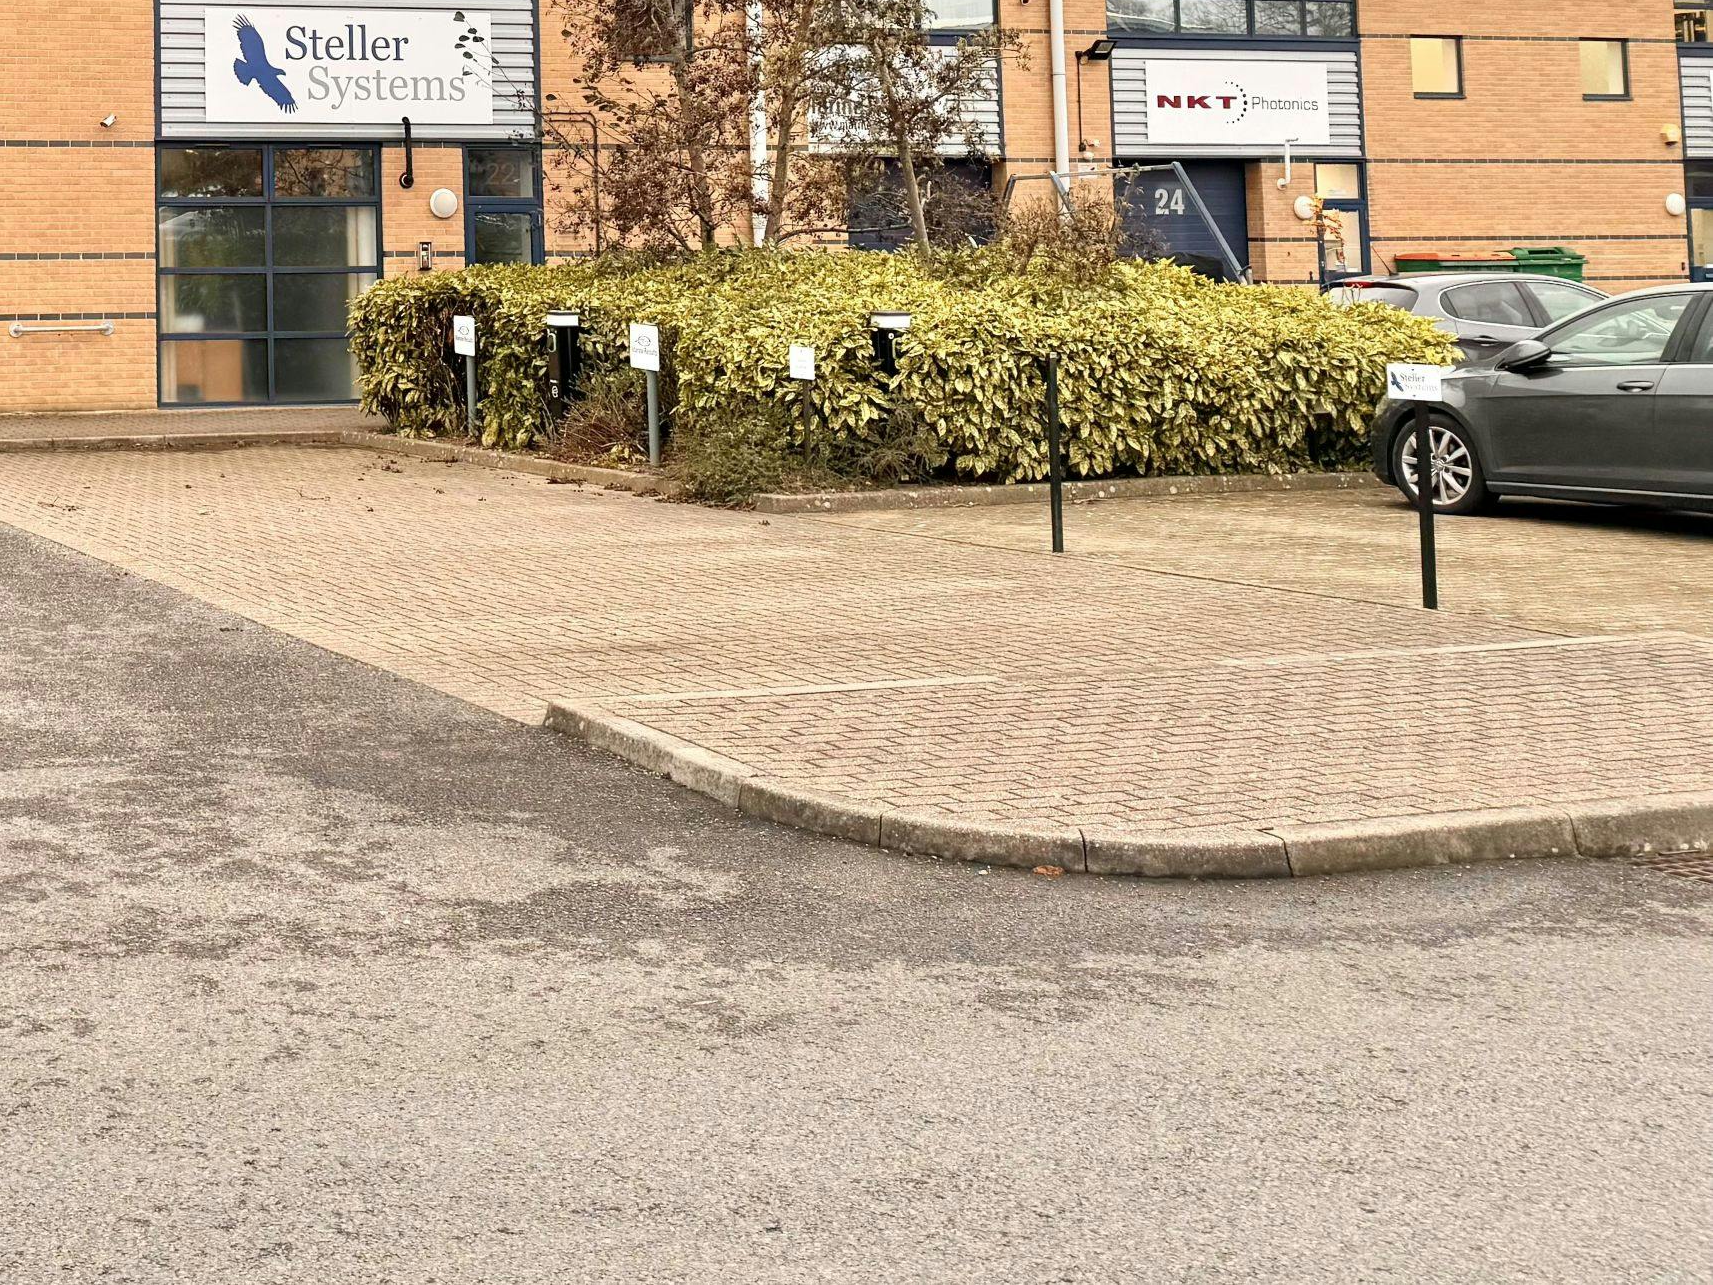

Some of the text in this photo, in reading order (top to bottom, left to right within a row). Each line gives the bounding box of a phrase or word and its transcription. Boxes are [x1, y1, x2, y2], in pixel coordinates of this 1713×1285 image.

[286, 24, 409, 62] Steller
[307, 65, 466, 110] Systems
[1156, 95, 1319, 112] NKT Photonics
[486, 162, 519, 186] 22
[1154, 188, 1185, 216] 24
